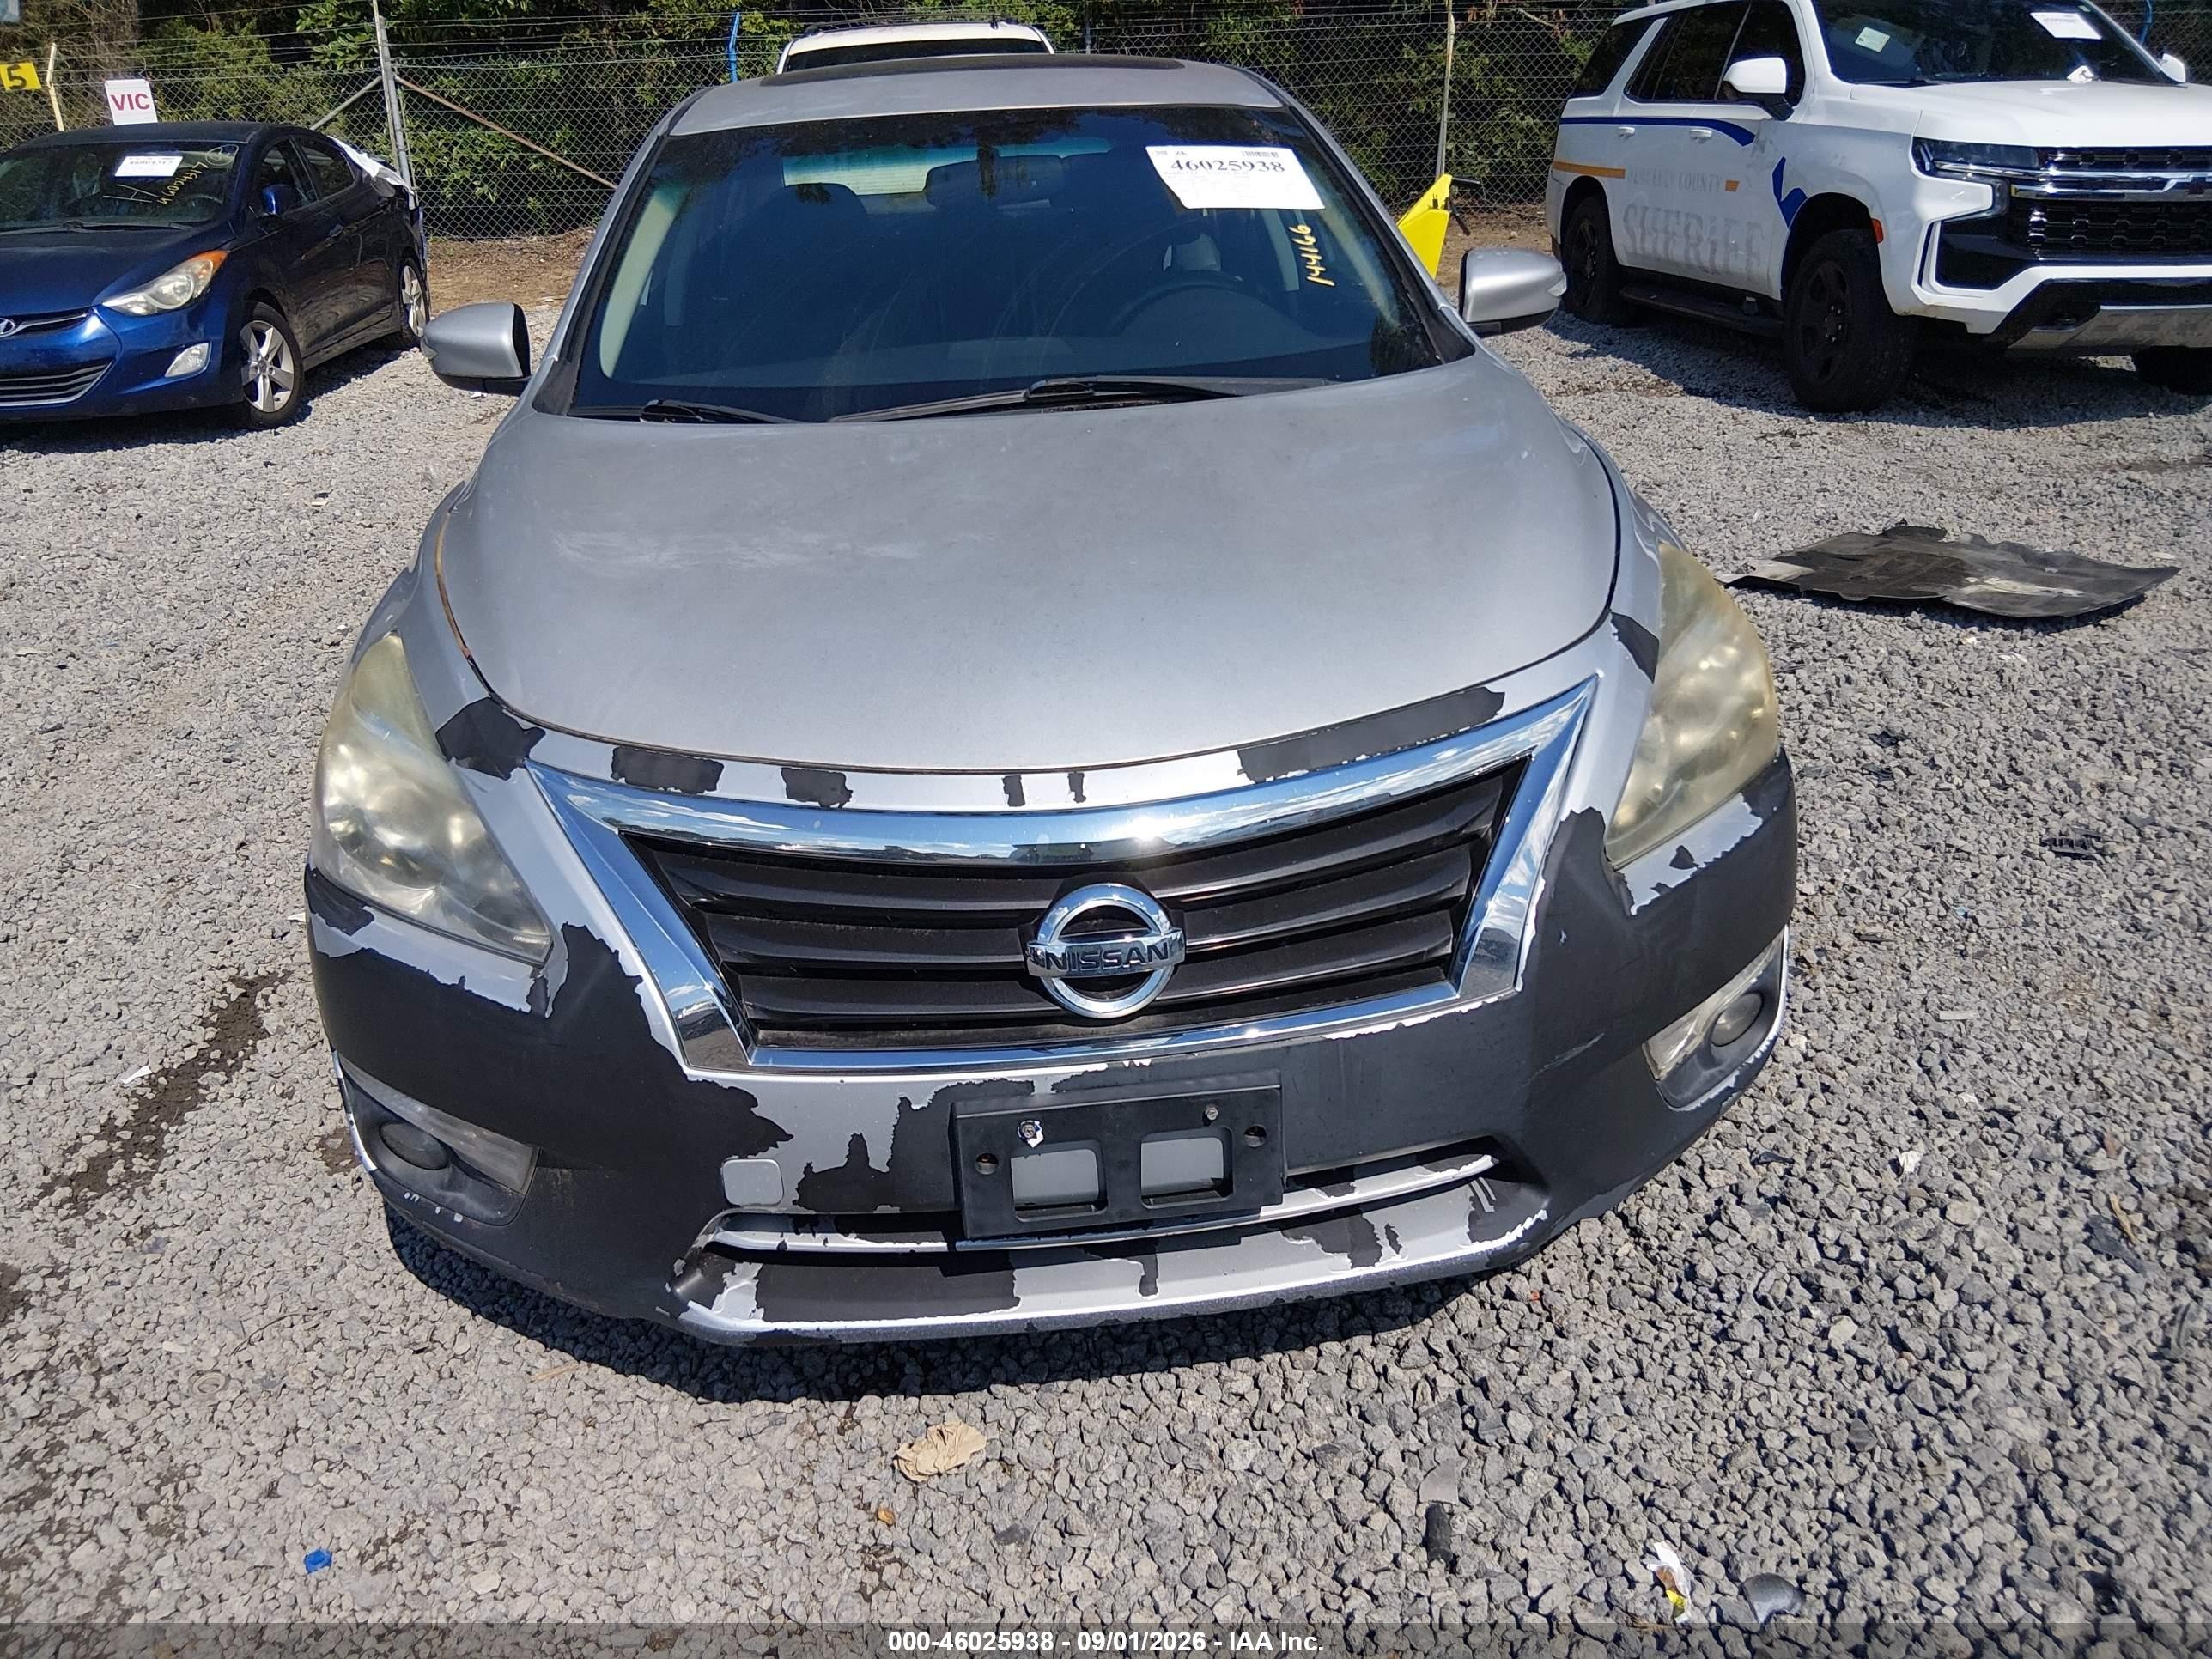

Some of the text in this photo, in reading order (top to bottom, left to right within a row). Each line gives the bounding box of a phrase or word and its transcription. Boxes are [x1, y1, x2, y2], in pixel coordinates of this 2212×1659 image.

[7, 64, 27, 89] 5
[109, 93, 151, 112] VIC
[1170, 159, 1285, 173] 46025938
[1288, 223, 1336, 287] 144166
[1044, 941, 1170, 972] NISSAN
